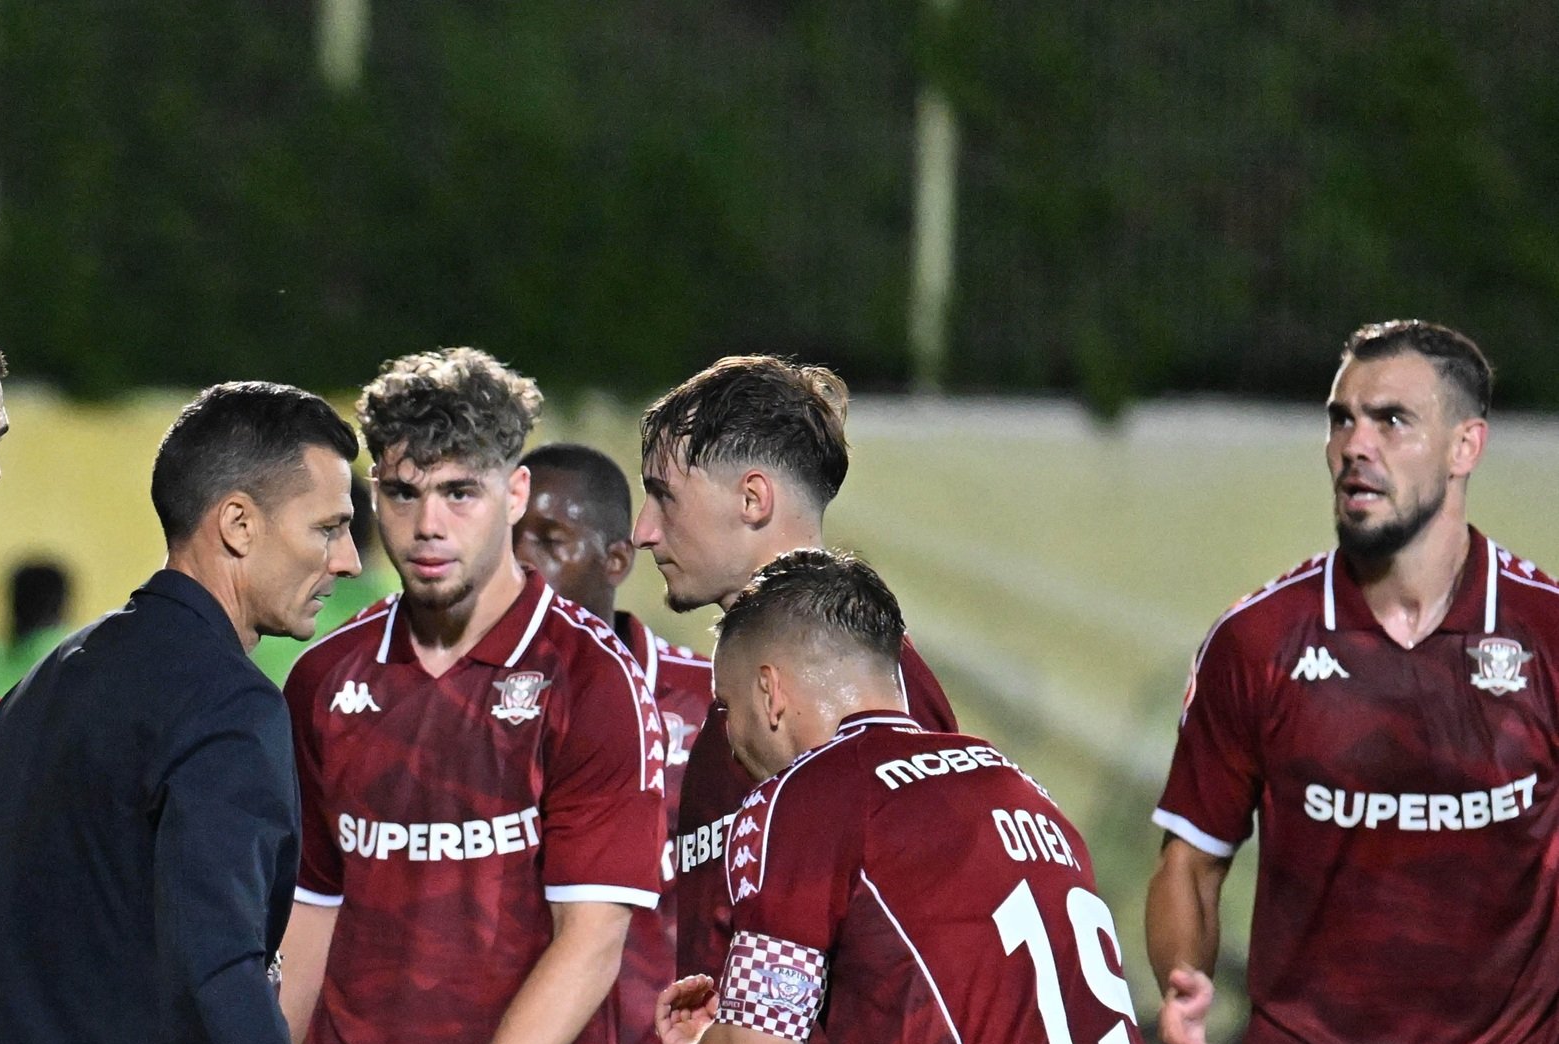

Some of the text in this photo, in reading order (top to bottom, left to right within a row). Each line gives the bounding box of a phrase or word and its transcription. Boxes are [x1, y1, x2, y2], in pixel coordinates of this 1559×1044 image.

[1303, 773, 1538, 832] SUPERBET
[338, 806, 541, 862] SUPERBET
[778, 967, 806, 981] RAPID
